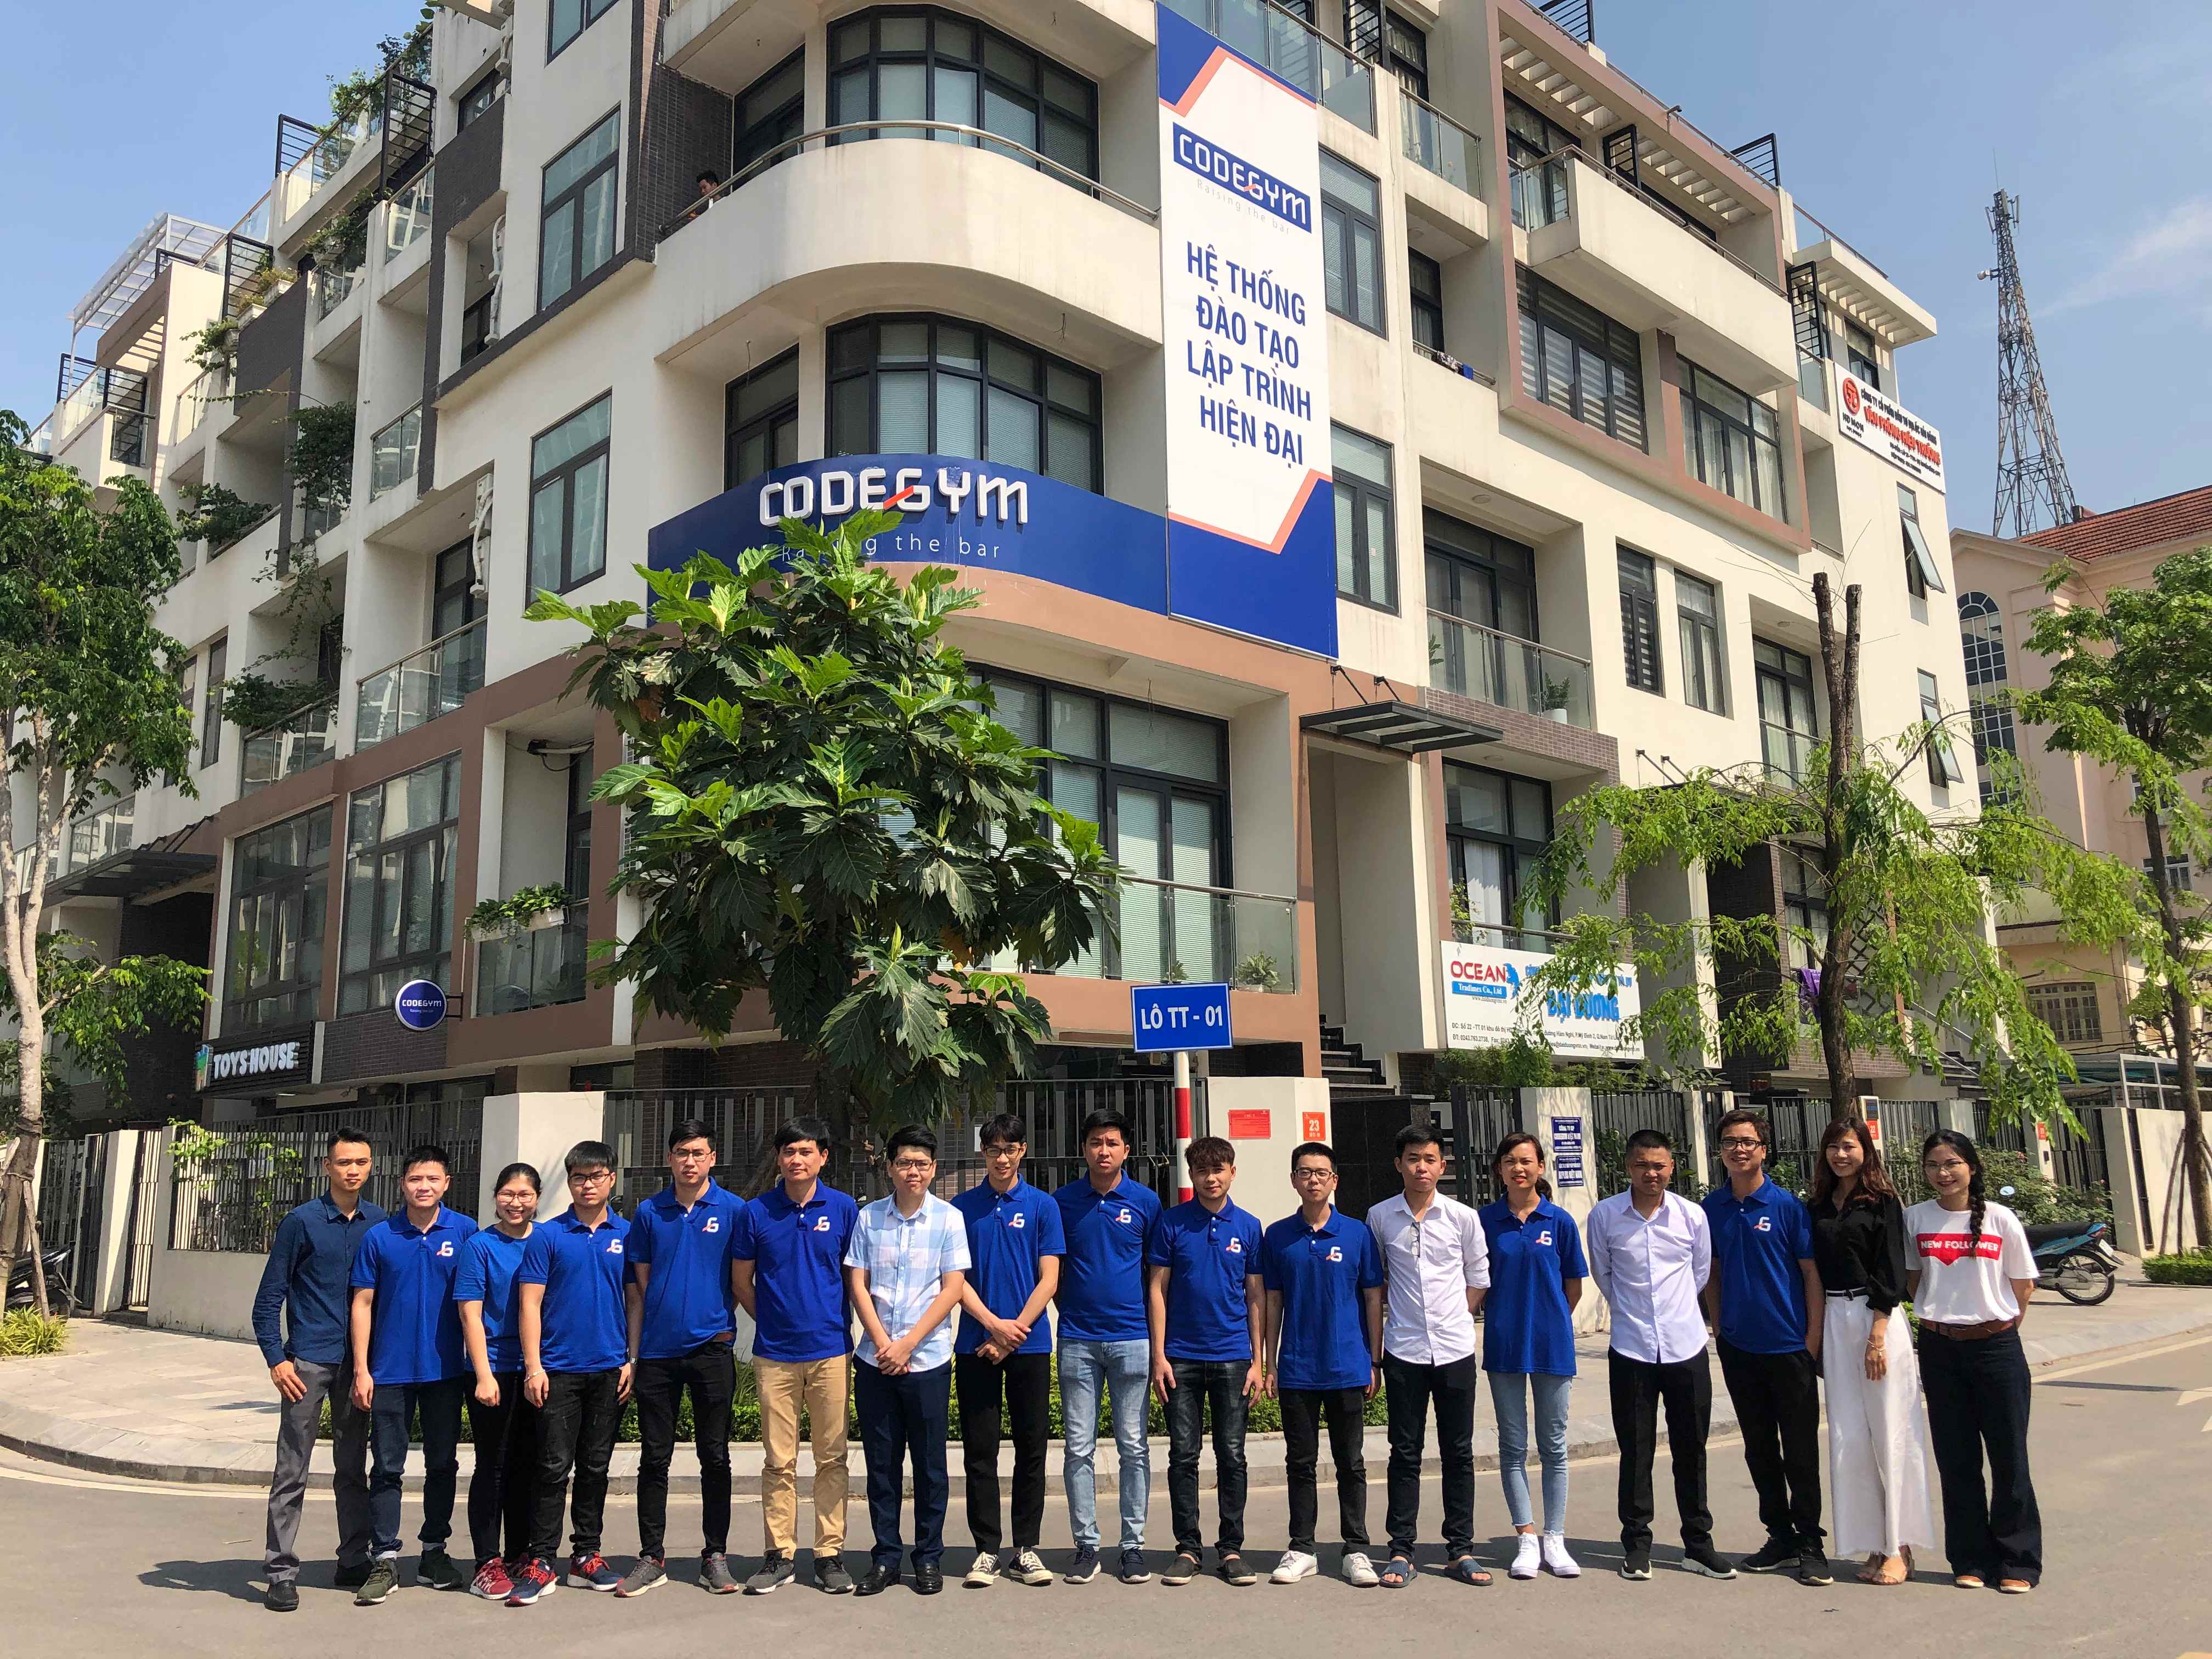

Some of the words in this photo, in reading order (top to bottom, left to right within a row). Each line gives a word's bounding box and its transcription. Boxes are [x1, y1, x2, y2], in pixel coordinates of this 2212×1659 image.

[1180, 133, 1306, 224] CODEGYM
[1197, 178, 1241, 212] Raising
[1248, 206, 1265, 222] the
[1273, 218, 1289, 234] bar
[1187, 241, 1218, 292] HỆ
[1226, 259, 1305, 326] THỐNG
[1196, 295, 1246, 346] ĐÀO
[1255, 320, 1299, 368] TẠO
[1187, 339, 1233, 388] LẬP
[1241, 362, 1311, 422] TRÌNH
[1200, 394, 1256, 448] HIỆN
[1264, 421, 1303, 469] ĐẠI
[759, 467, 1028, 527] CODEGYM
[895, 533, 940, 551] the
[959, 537, 1000, 558] bar
[1451, 960, 1505, 983] OCEAN
[1493, 986, 1502, 995] Ltd
[1141, 1003, 1163, 1030] LÔ
[1167, 1007, 1189, 1028] TT
[1205, 1005, 1223, 1027] 01
[213, 1049, 247, 1080] TOYS
[250, 1041, 297, 1075] HOUSE
[1309, 1119, 1320, 1132] 23
[1921, 1240, 1942, 1249] NEW
